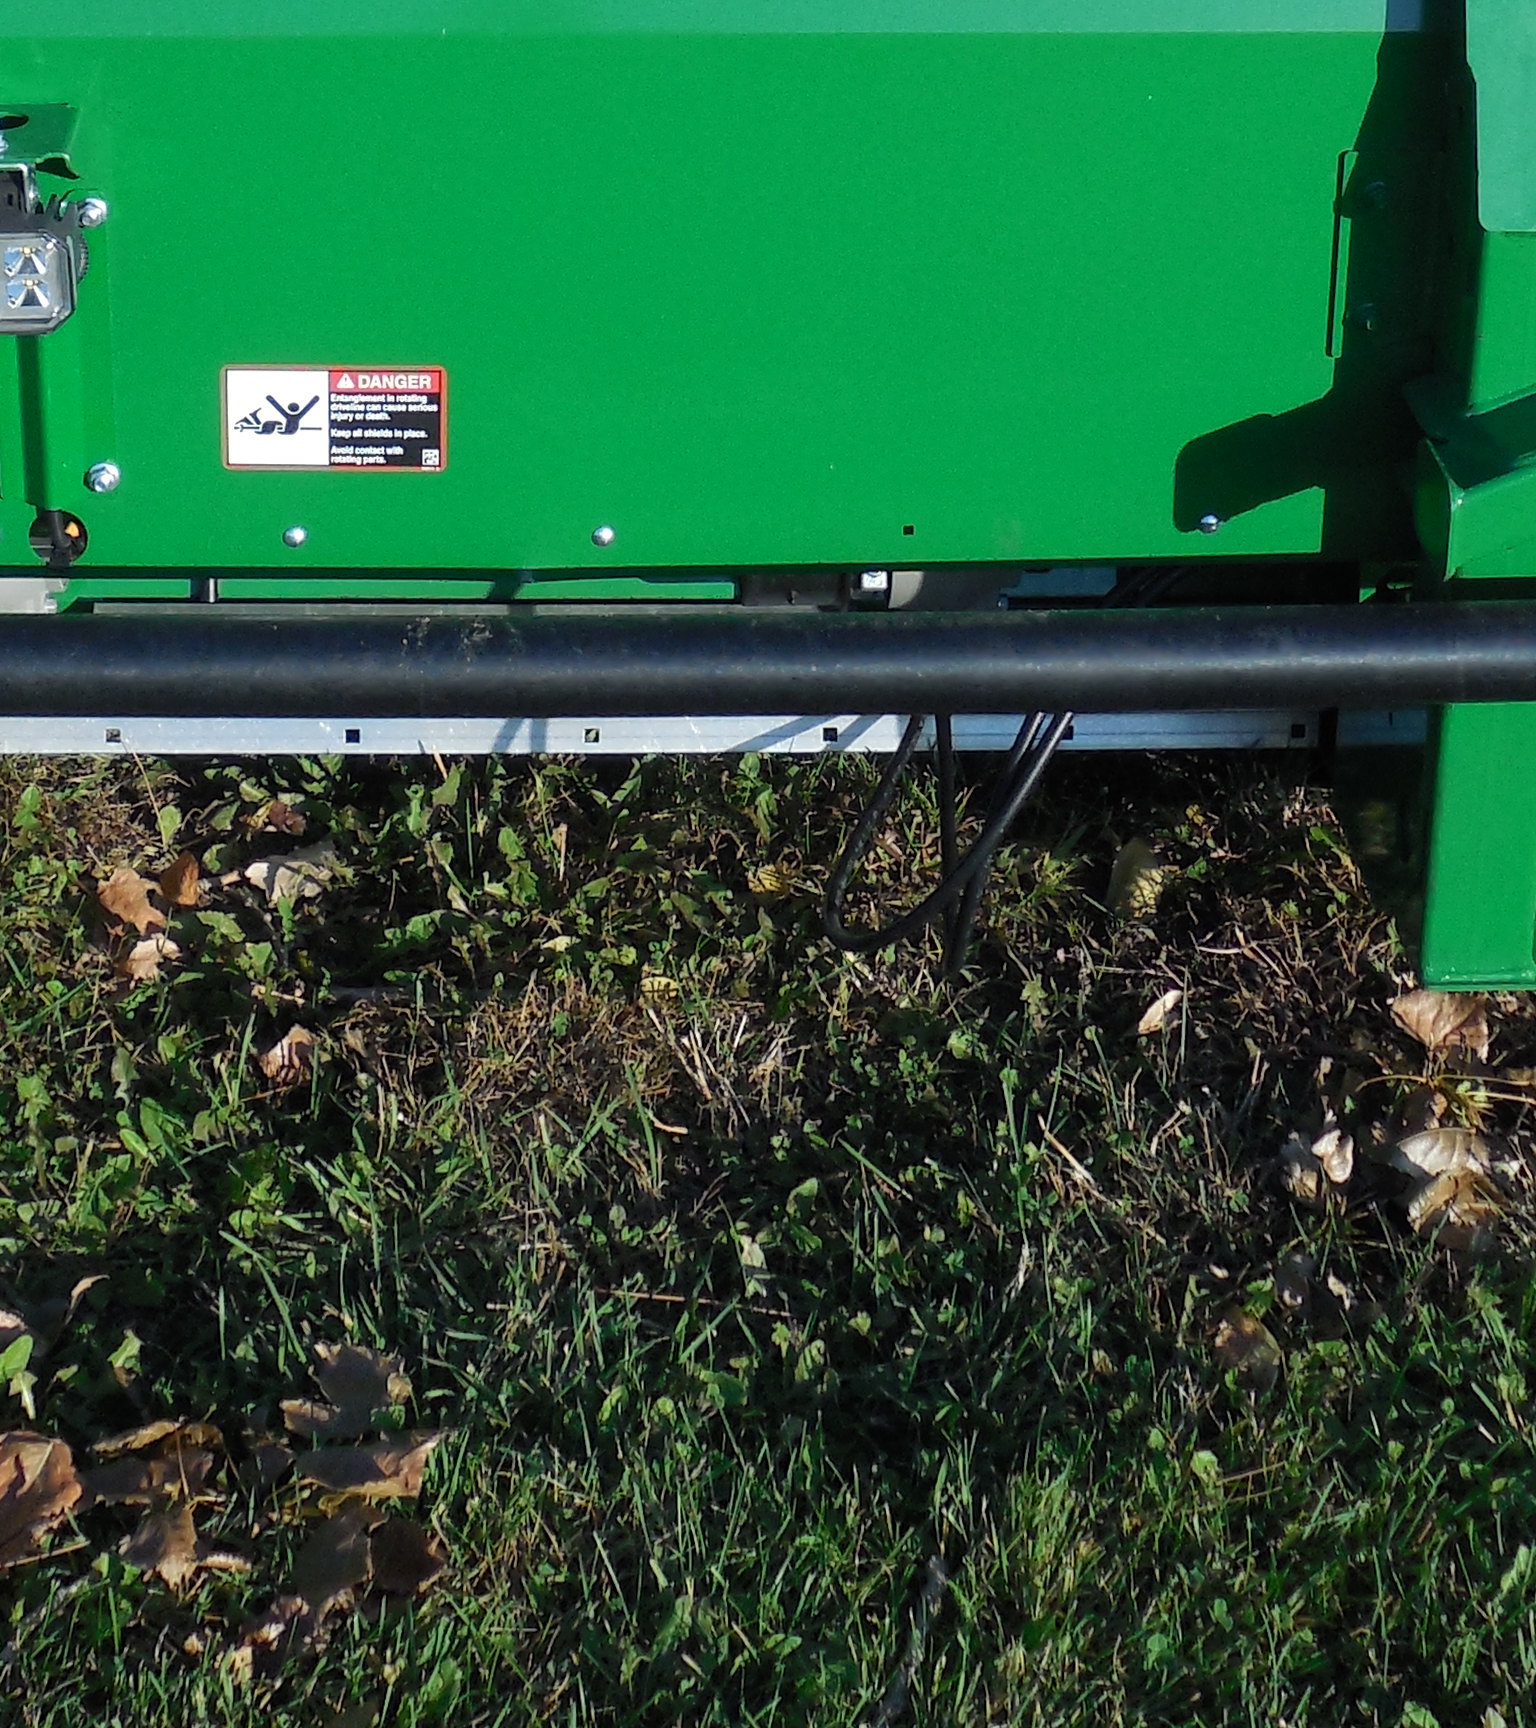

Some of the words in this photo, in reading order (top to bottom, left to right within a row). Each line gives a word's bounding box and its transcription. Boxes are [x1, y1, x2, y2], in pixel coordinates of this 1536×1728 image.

[358, 374, 432, 389] DANGER
[330, 393, 386, 403] Entanglement
[386, 394, 395, 402] in
[396, 394, 428, 404] rotating
[408, 403, 439, 412] serious
[330, 412, 354, 421] injury
[365, 412, 391, 420] death.
[330, 428, 352, 439] Keep
[352, 428, 363, 438] all
[364, 428, 393, 438] shields
[394, 428, 403, 438] in
[403, 429, 428, 440] place.
[331, 445, 354, 455] Avoid
[355, 446, 385, 455] contact
[386, 446, 404, 455] with
[331, 455, 362, 465] rotating
[363, 456, 387, 465] parts.
